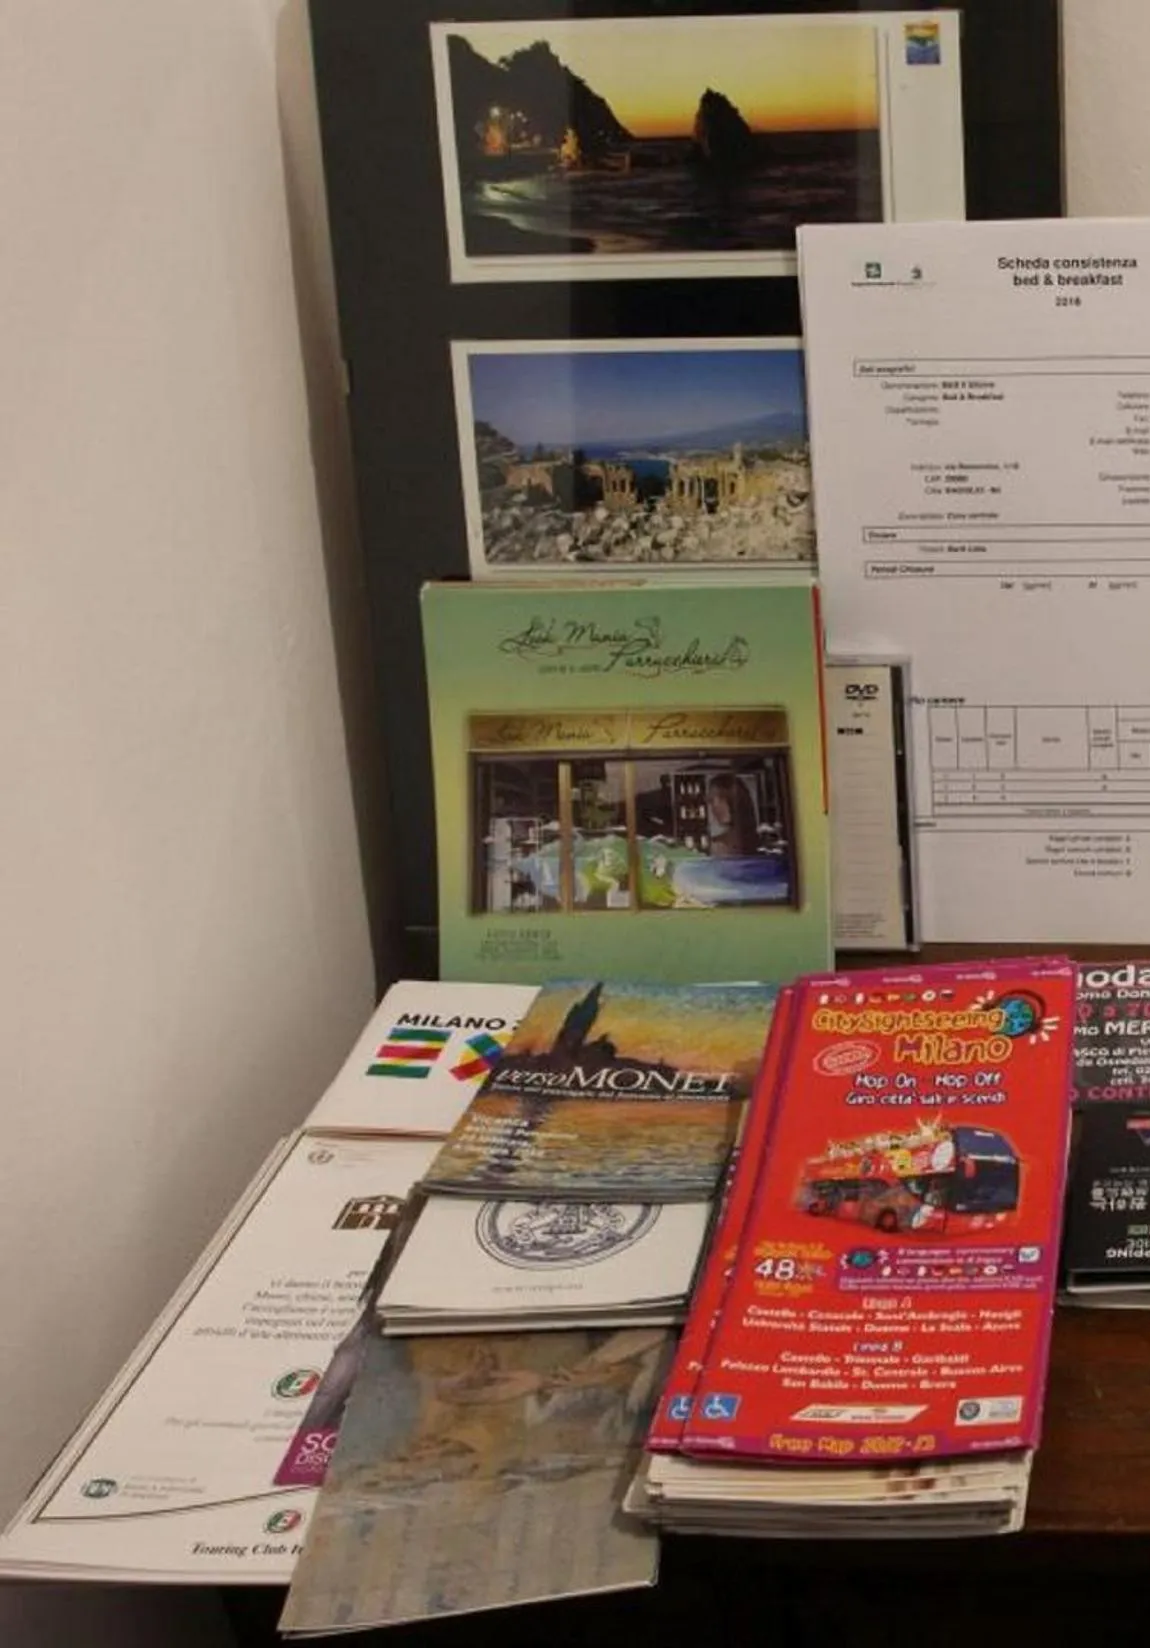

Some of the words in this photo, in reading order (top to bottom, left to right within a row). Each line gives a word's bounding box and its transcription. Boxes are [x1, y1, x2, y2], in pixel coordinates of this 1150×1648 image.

[998, 256, 1048, 271] Scheda
[1052, 256, 1138, 271] consistenza
[1013, 273, 1038, 287] bed
[1043, 274, 1055, 287] &
[1057, 273, 1124, 288] breakfast
[845, 683, 880, 696] DVD
[397, 1012, 507, 1032] MILANO
[894, 1034, 1013, 1065] Milano
[495, 1066, 737, 1095] versoMONET
[855, 1073, 889, 1089] Hop
[895, 1074, 918, 1088] On
[934, 1073, 968, 1089] Hop
[974, 1071, 1004, 1086] Off
[754, 1257, 797, 1281] 48
[747, 1306, 797, 1319] Castello
[863, 1322, 910, 1333] Duomo
[911, 1352, 970, 1365] Garibaldi
[191, 1542, 249, 1558] Touring
[251, 1541, 288, 1556] Club
